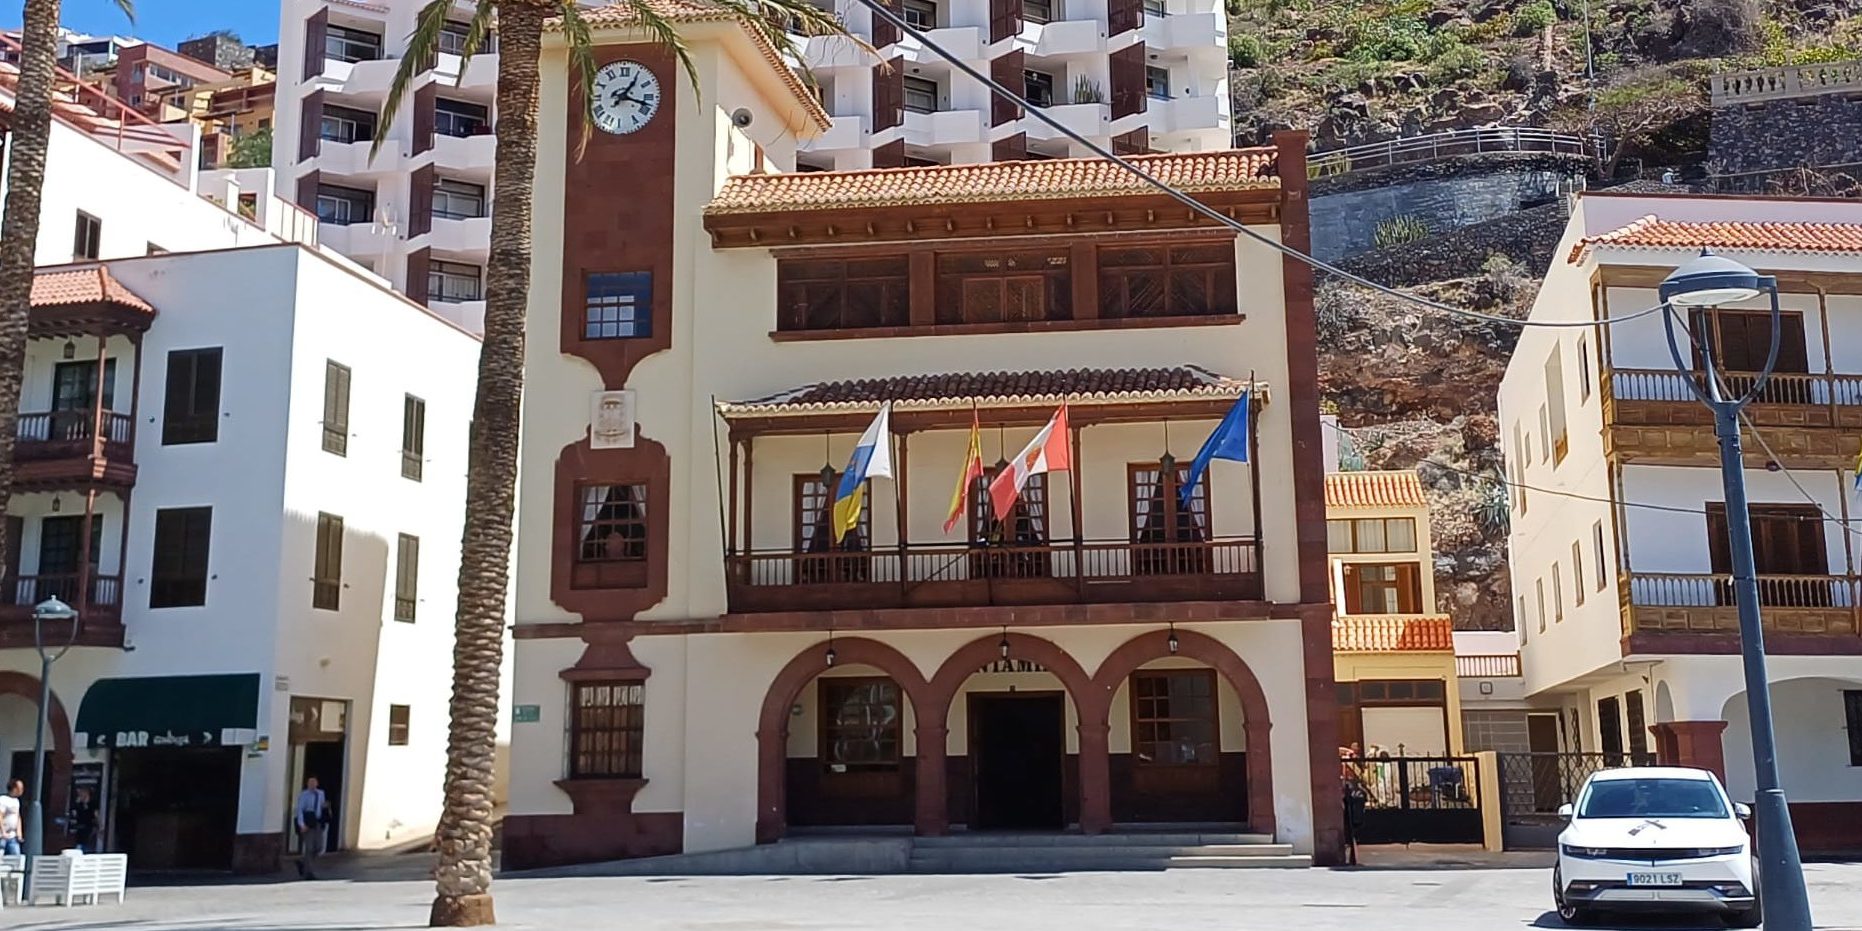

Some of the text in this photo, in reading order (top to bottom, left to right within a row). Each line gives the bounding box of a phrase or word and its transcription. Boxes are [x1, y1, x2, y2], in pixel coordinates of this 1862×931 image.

[116, 731, 149, 747] BAR
[1633, 873, 1681, 884] 9021 LSZ
